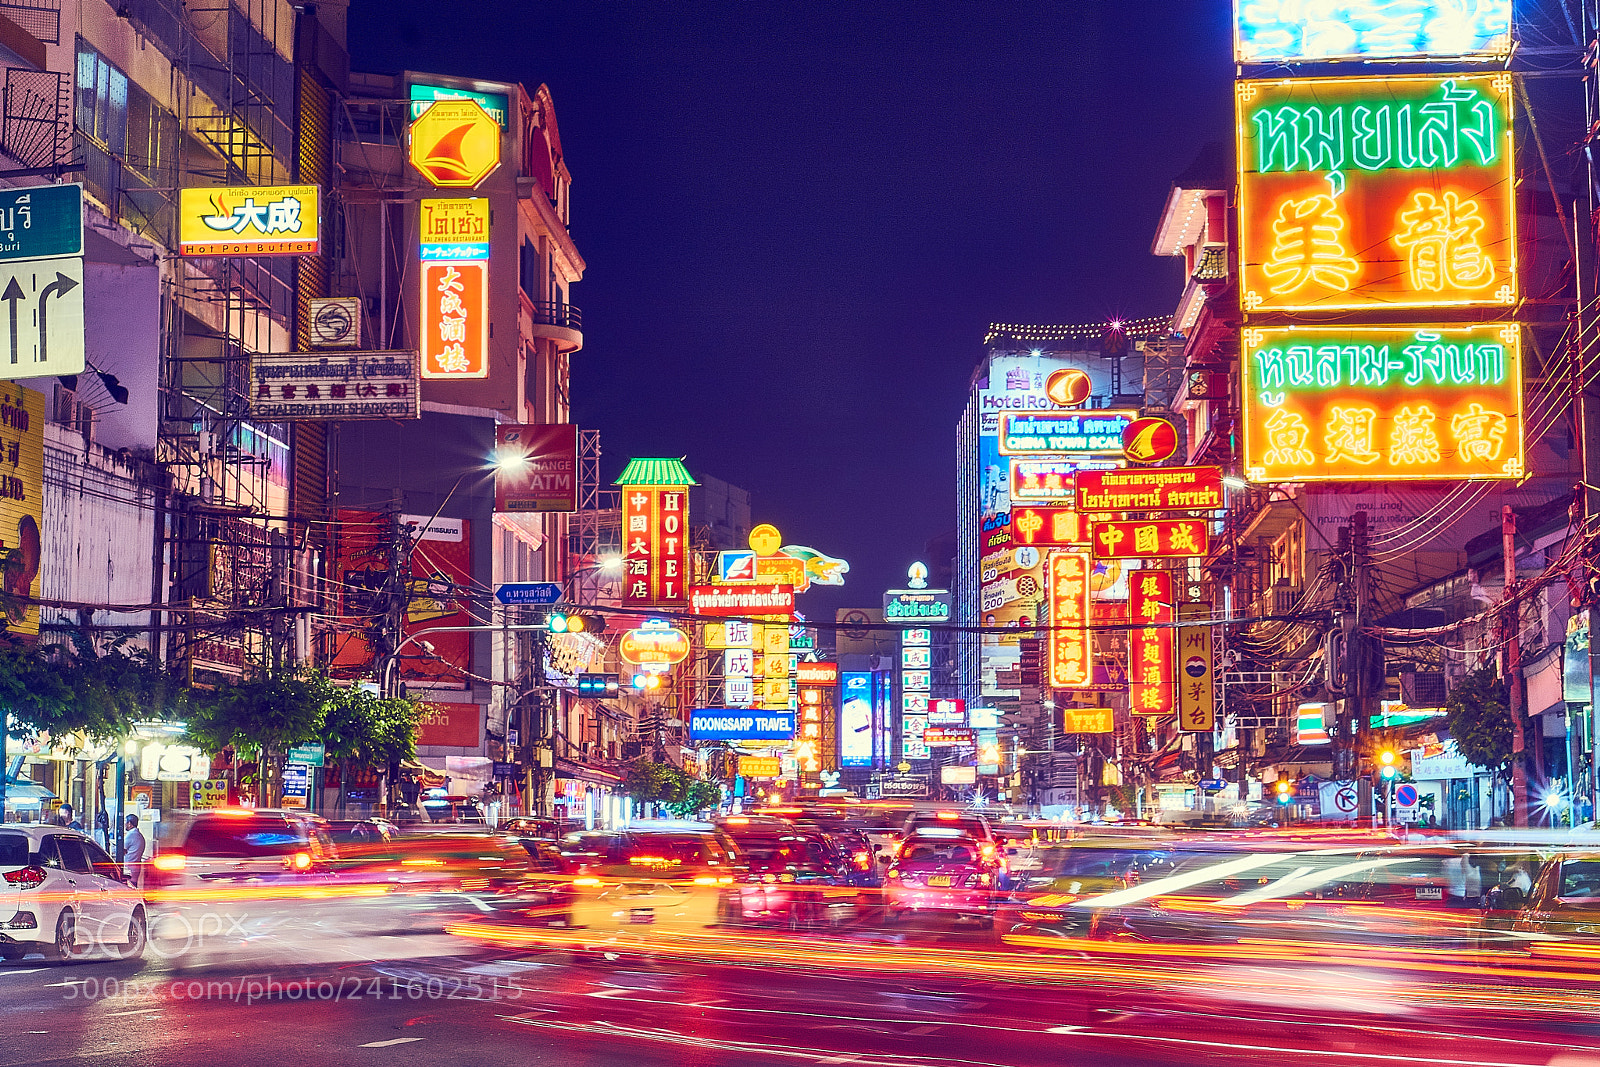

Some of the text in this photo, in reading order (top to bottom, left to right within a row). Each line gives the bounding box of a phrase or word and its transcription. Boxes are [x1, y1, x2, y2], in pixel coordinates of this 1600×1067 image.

[1253, 80, 1496, 200] หมุยเล้ง
[186, 242, 312, 254] Hot Pot Buffet
[1263, 192, 1496, 293] 美龍
[983, 395, 1025, 408] Hotel
[1088, 436, 1122, 449] SCAL
[530, 473, 570, 490] ATM
[629, 492, 650, 599] 中國大酒店
[664, 493, 679, 599] HOTEL
[1099, 523, 1198, 556] 中國城
[983, 569, 996, 581] 20
[984, 597, 1003, 611] 200
[692, 717, 792, 731] ROONGSARP TRAVEL
[206, 790, 227, 801] true
